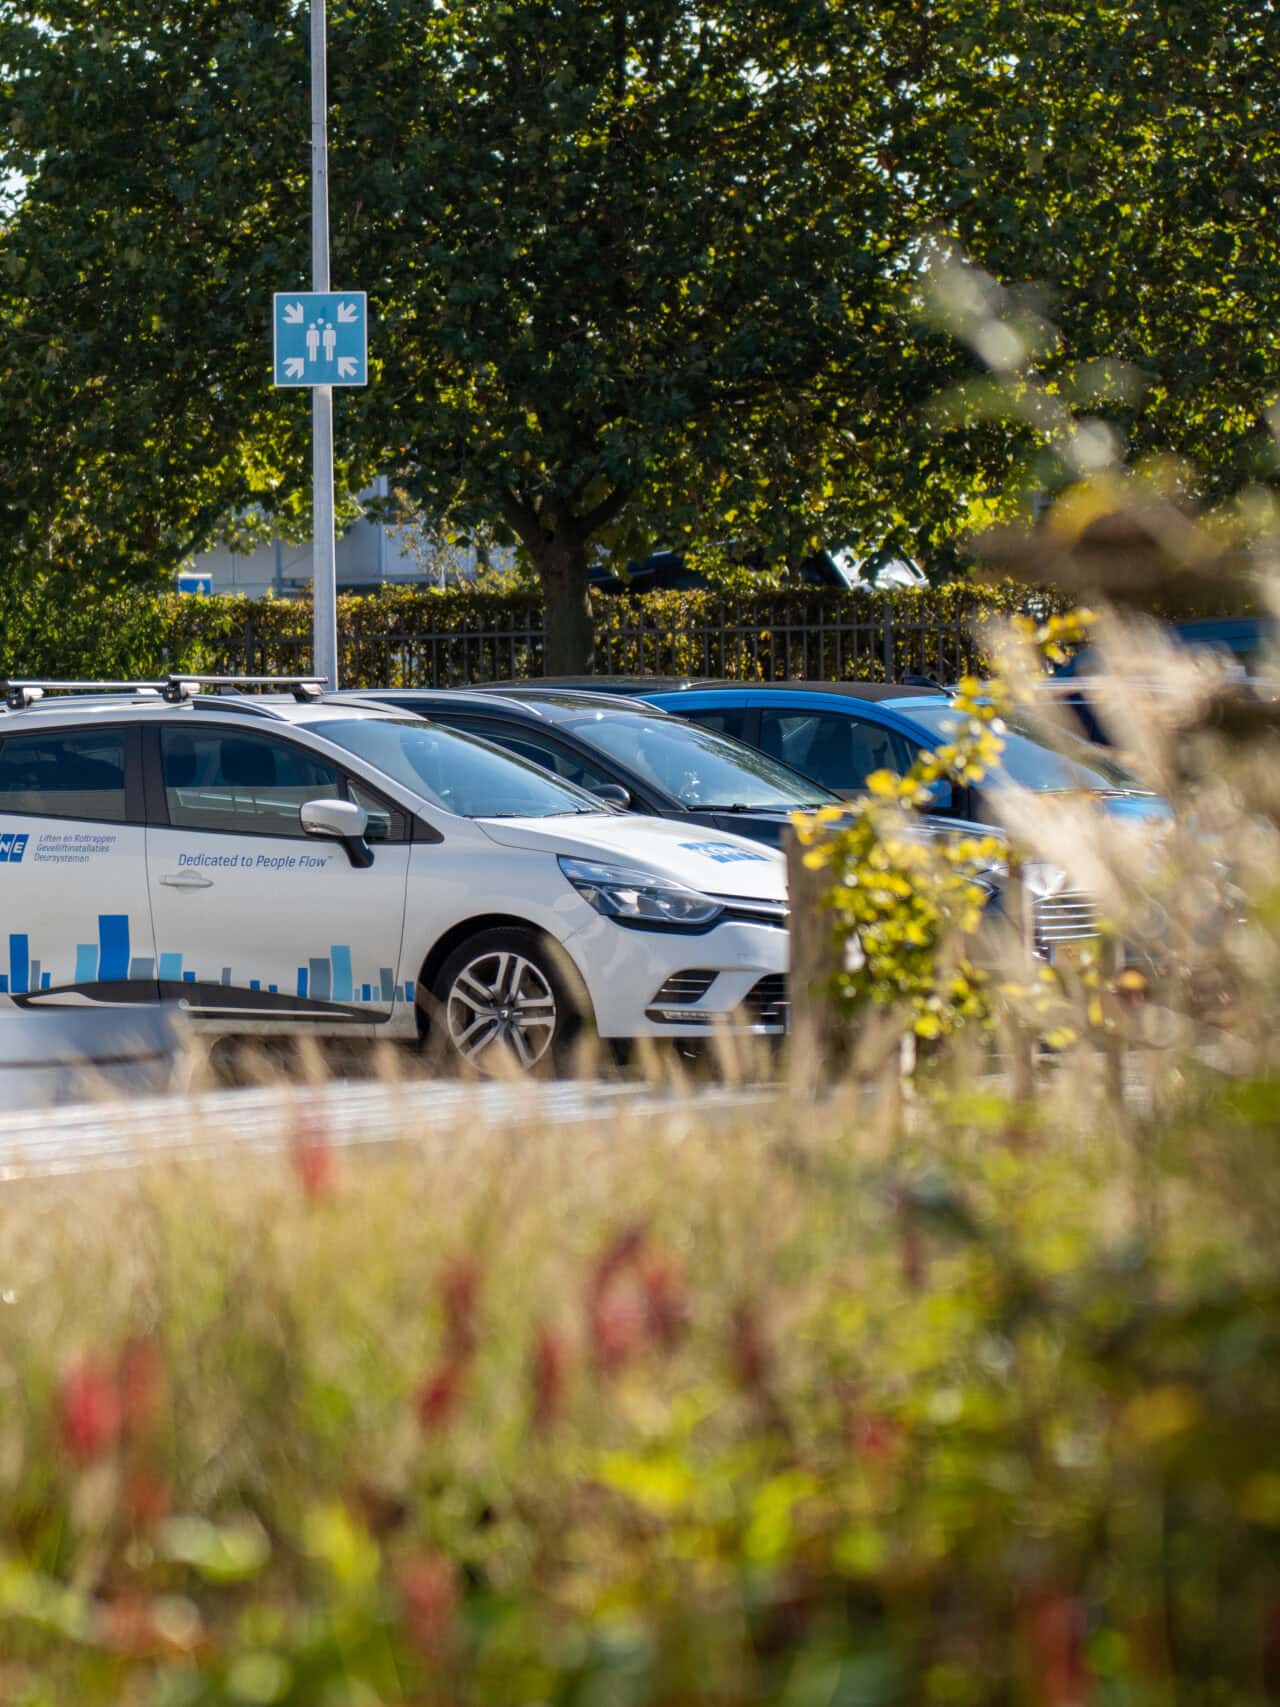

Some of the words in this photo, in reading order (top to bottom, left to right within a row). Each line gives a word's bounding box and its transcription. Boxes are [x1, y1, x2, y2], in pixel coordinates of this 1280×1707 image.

[34, 853, 90, 864] Deursystemen
[178, 853, 238, 867] Dedicated
[240, 855, 253, 867] to
[256, 855, 296, 870] People
